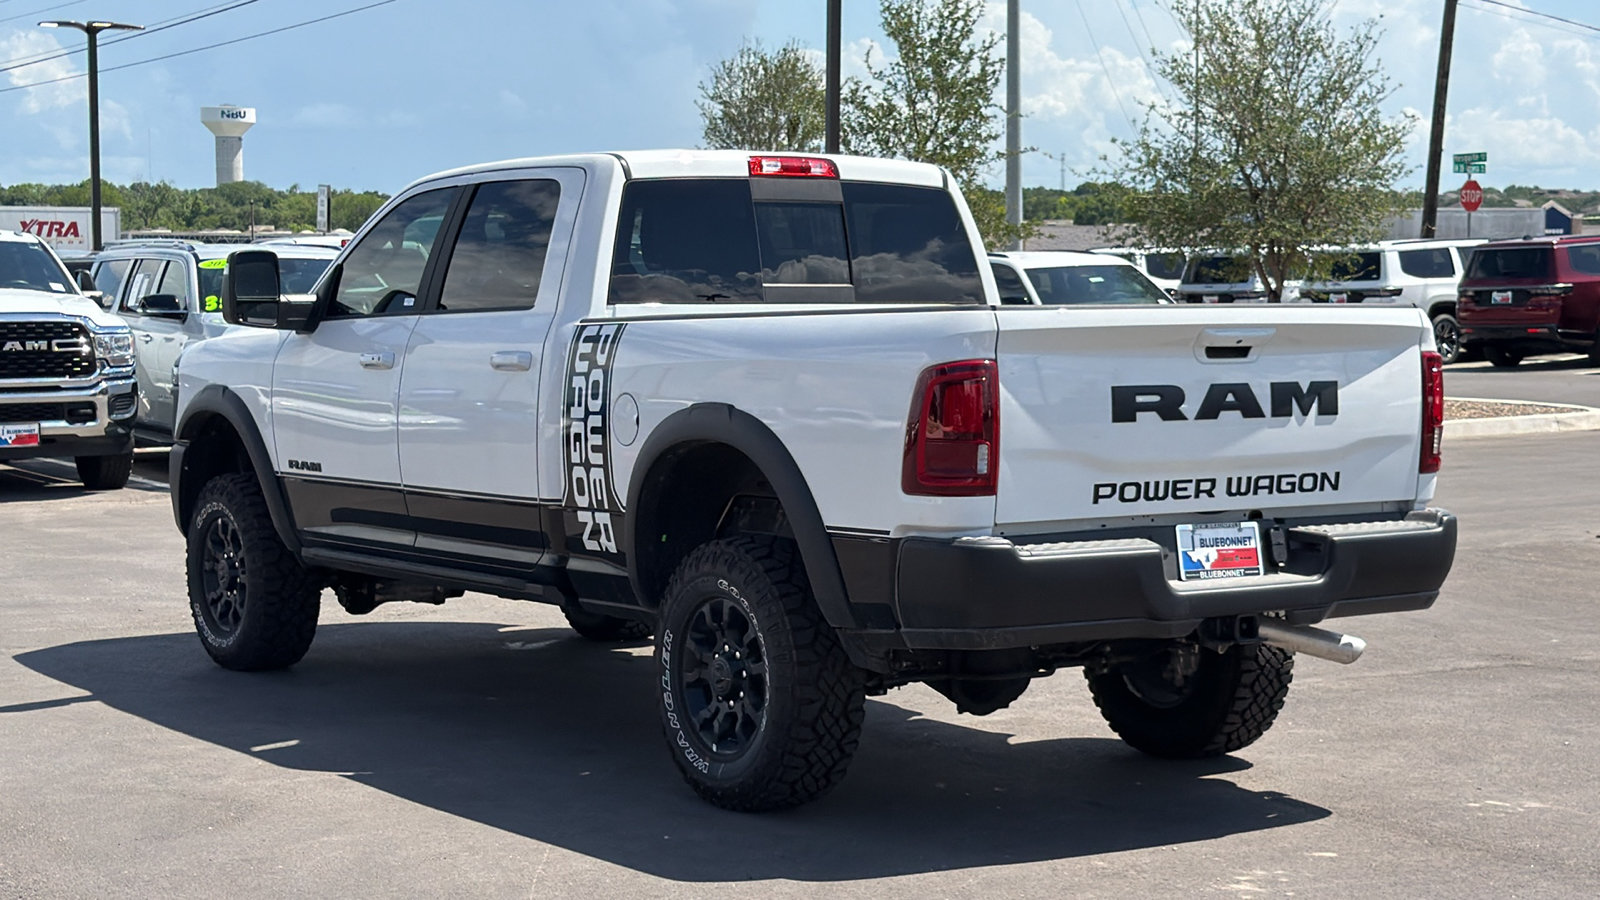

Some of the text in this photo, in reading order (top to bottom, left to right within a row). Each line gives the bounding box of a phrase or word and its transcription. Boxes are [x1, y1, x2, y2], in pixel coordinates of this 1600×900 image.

[220, 110, 247, 119] NBU
[1461, 190, 1481, 203] STOP
[20, 219, 80, 238] XTRA
[1111, 381, 1338, 423] RAM
[570, 326, 601, 551] WAGON
[587, 324, 618, 554] POWER
[288, 459, 322, 473] RAM
[1092, 471, 1340, 504] POWER WAGON
[1199, 536, 1252, 548] BLUEBONNET
[1200, 569, 1245, 579] BLUEBONNET
[661, 629, 710, 774] WRANGLER
